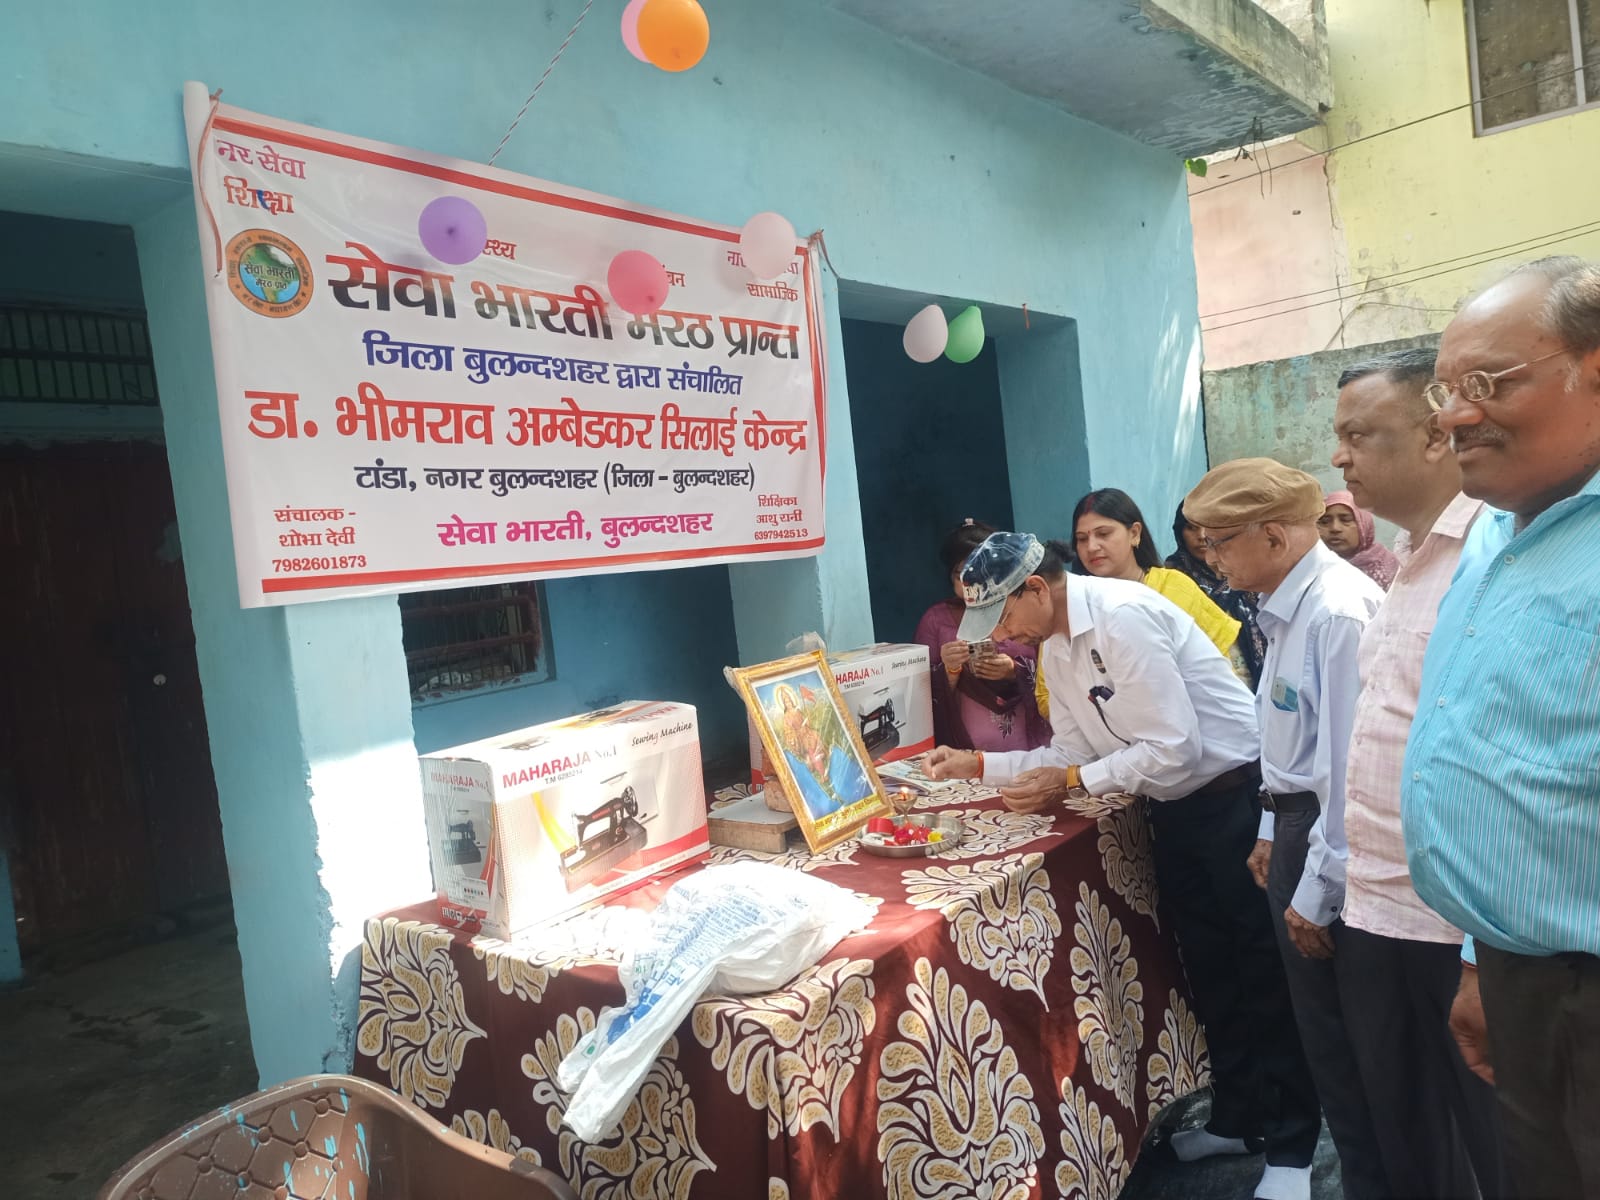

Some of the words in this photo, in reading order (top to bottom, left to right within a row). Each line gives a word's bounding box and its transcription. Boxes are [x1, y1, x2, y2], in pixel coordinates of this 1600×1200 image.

[217, 140, 253, 164] नर
[256, 145, 306, 179] सेवा
[224, 176, 294, 215] शिक्षा
[244, 262, 263, 275] सेवा
[266, 266, 296, 280] भारती
[325, 241, 456, 318] सेवा
[470, 280, 614, 340] भारती
[627, 309, 714, 350] मरठ
[720, 316, 801, 359] प्रान्त
[746, 281, 798, 301] सामाजिक
[362, 330, 455, 372] जिला
[463, 347, 610, 385] बुलन्दशहर
[613, 362, 662, 389] द्वारा
[666, 361, 743, 395] संचालित
[244, 390, 318, 439] डा.
[335, 382, 495, 446] भीमराव
[506, 397, 655, 449] अम्बेडकर
[660, 403, 737, 457] सिलाई
[743, 409, 808, 455] केन्द्र
[354, 458, 417, 492] टांडा,
[424, 467, 484, 490] नगर
[488, 467, 599, 497] बुलन्दशहर
[274, 505, 345, 523] संचालक
[758, 494, 798, 507] शिक्षिका
[437, 514, 497, 547] सेवा
[506, 510, 592, 542] भारती,
[601, 513, 713, 548] बुलन्दशहर
[780, 509, 802, 522] रानी
[279, 529, 322, 547] शोभा
[326, 526, 355, 547] देवी
[272, 555, 367, 573] 7982601873
[836, 667, 870, 684] HARAJA
[502, 751, 591, 788] MAHARAJA
[632, 731, 660, 746] Sewing
[660, 721, 693, 738] Machine
